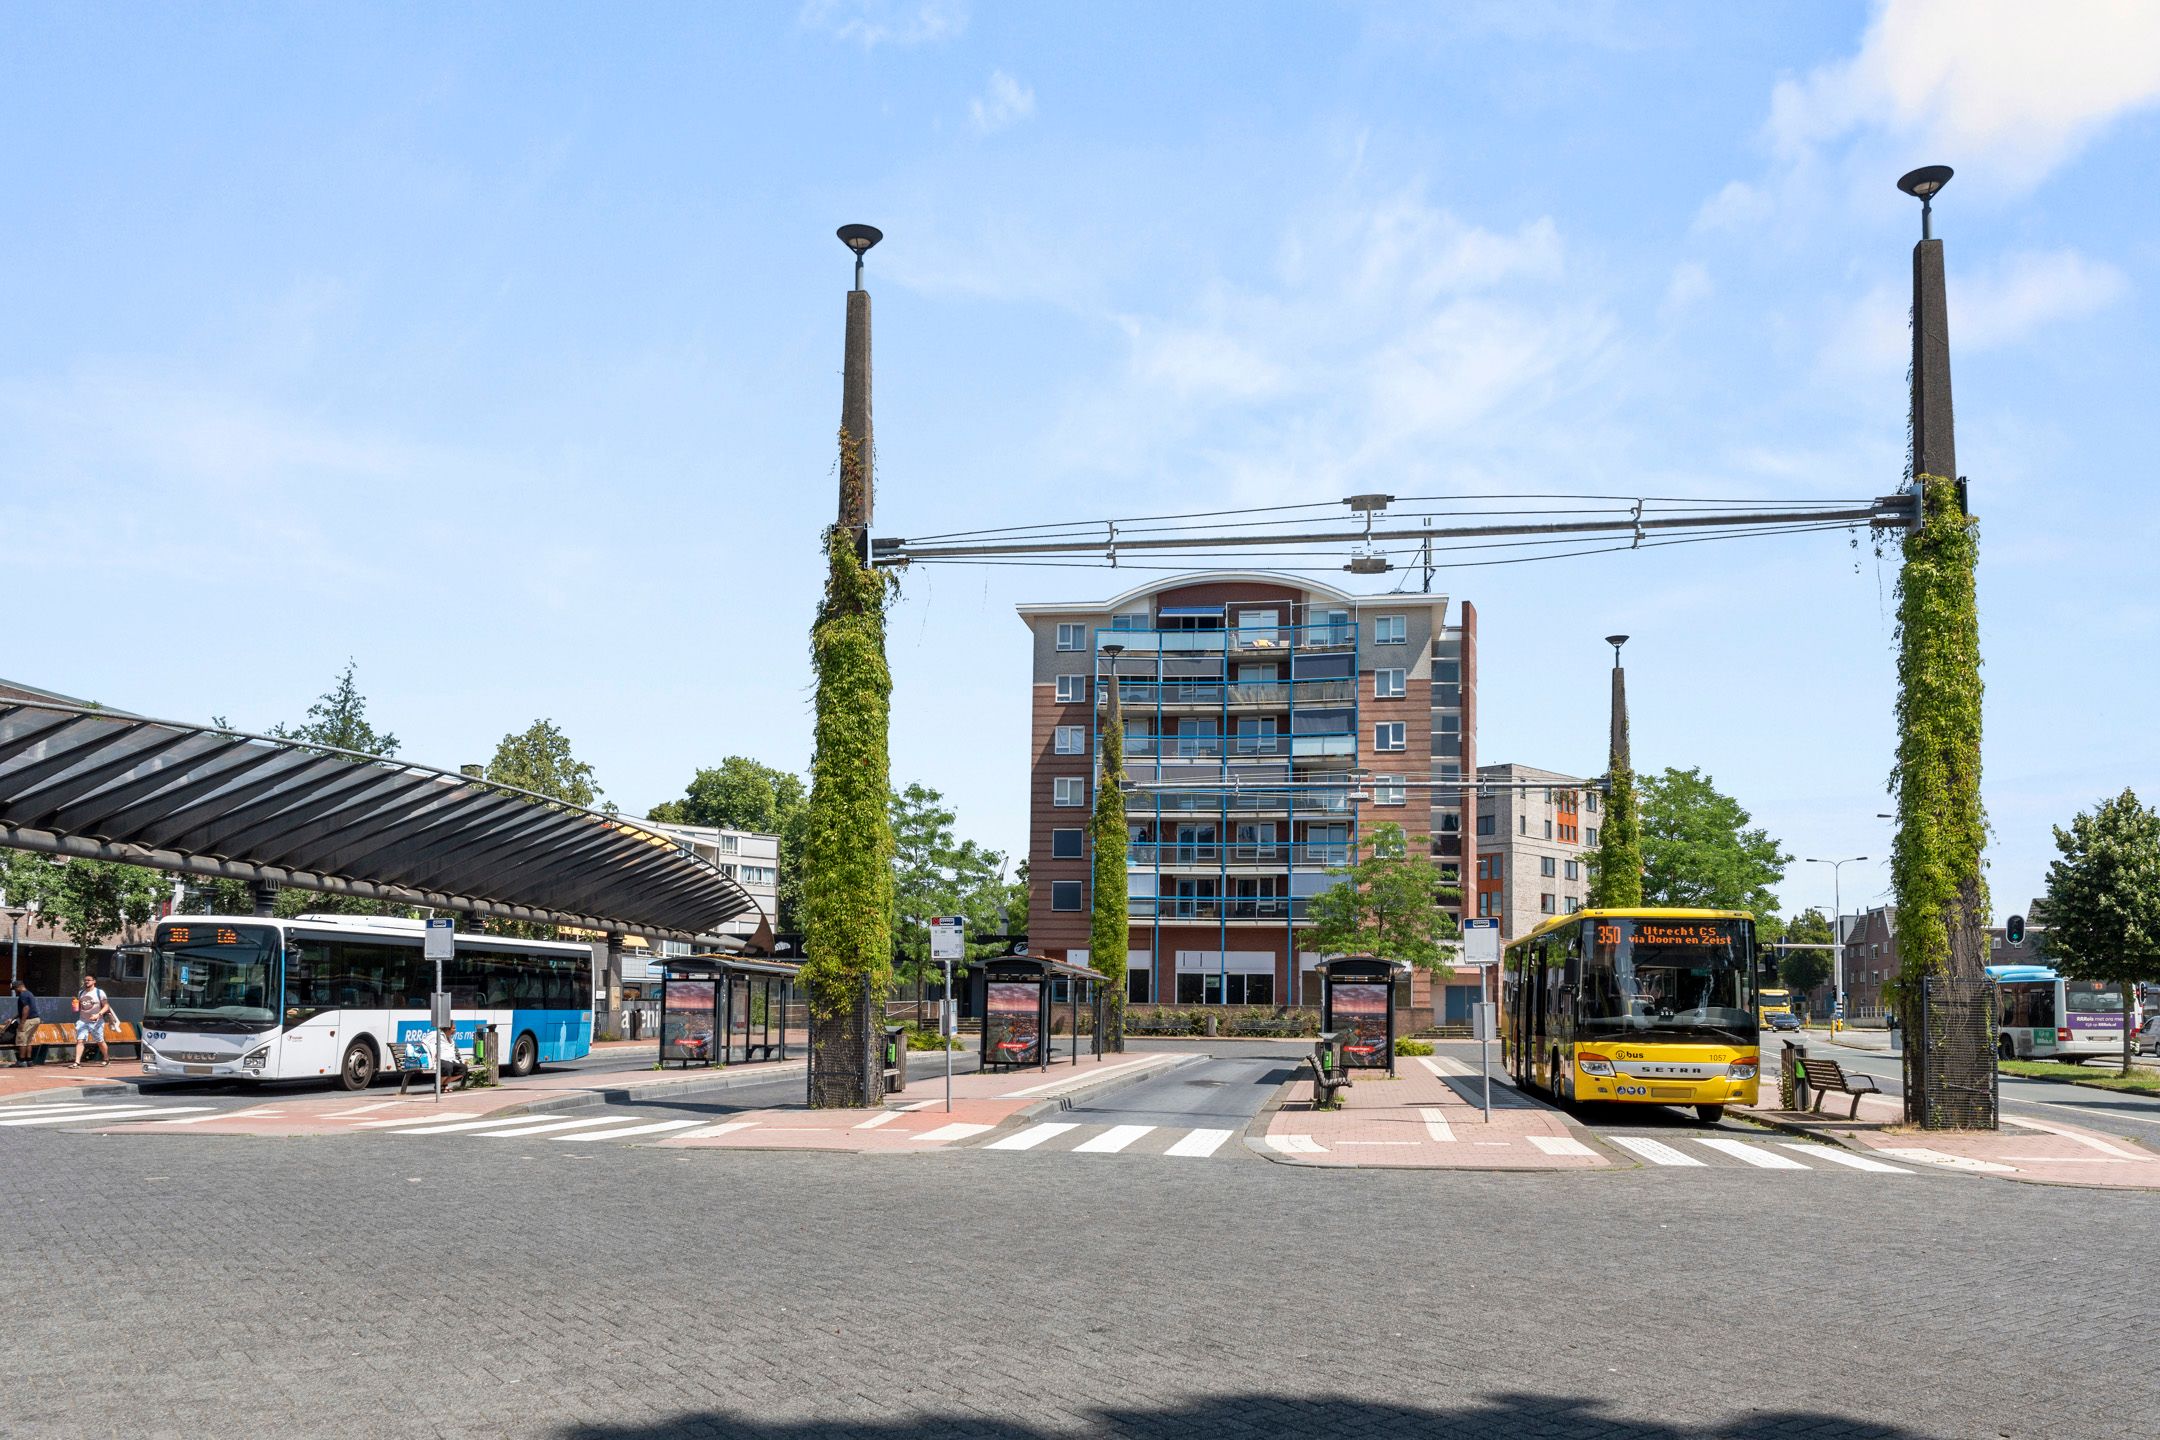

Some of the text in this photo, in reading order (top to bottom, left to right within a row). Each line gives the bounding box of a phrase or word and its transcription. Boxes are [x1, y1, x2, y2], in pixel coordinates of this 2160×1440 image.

[1597, 926, 1621, 944] 350
[1643, 926, 1717, 936] Utrecht CS
[1628, 935, 1644, 944] via
[1648, 935, 1683, 944] Doorn
[1702, 935, 1732, 944] Zeist
[182, 1053, 217, 1061] IVECO
[1709, 1054, 1727, 1062] 1057
[1641, 1066, 1701, 1074] SETRA
